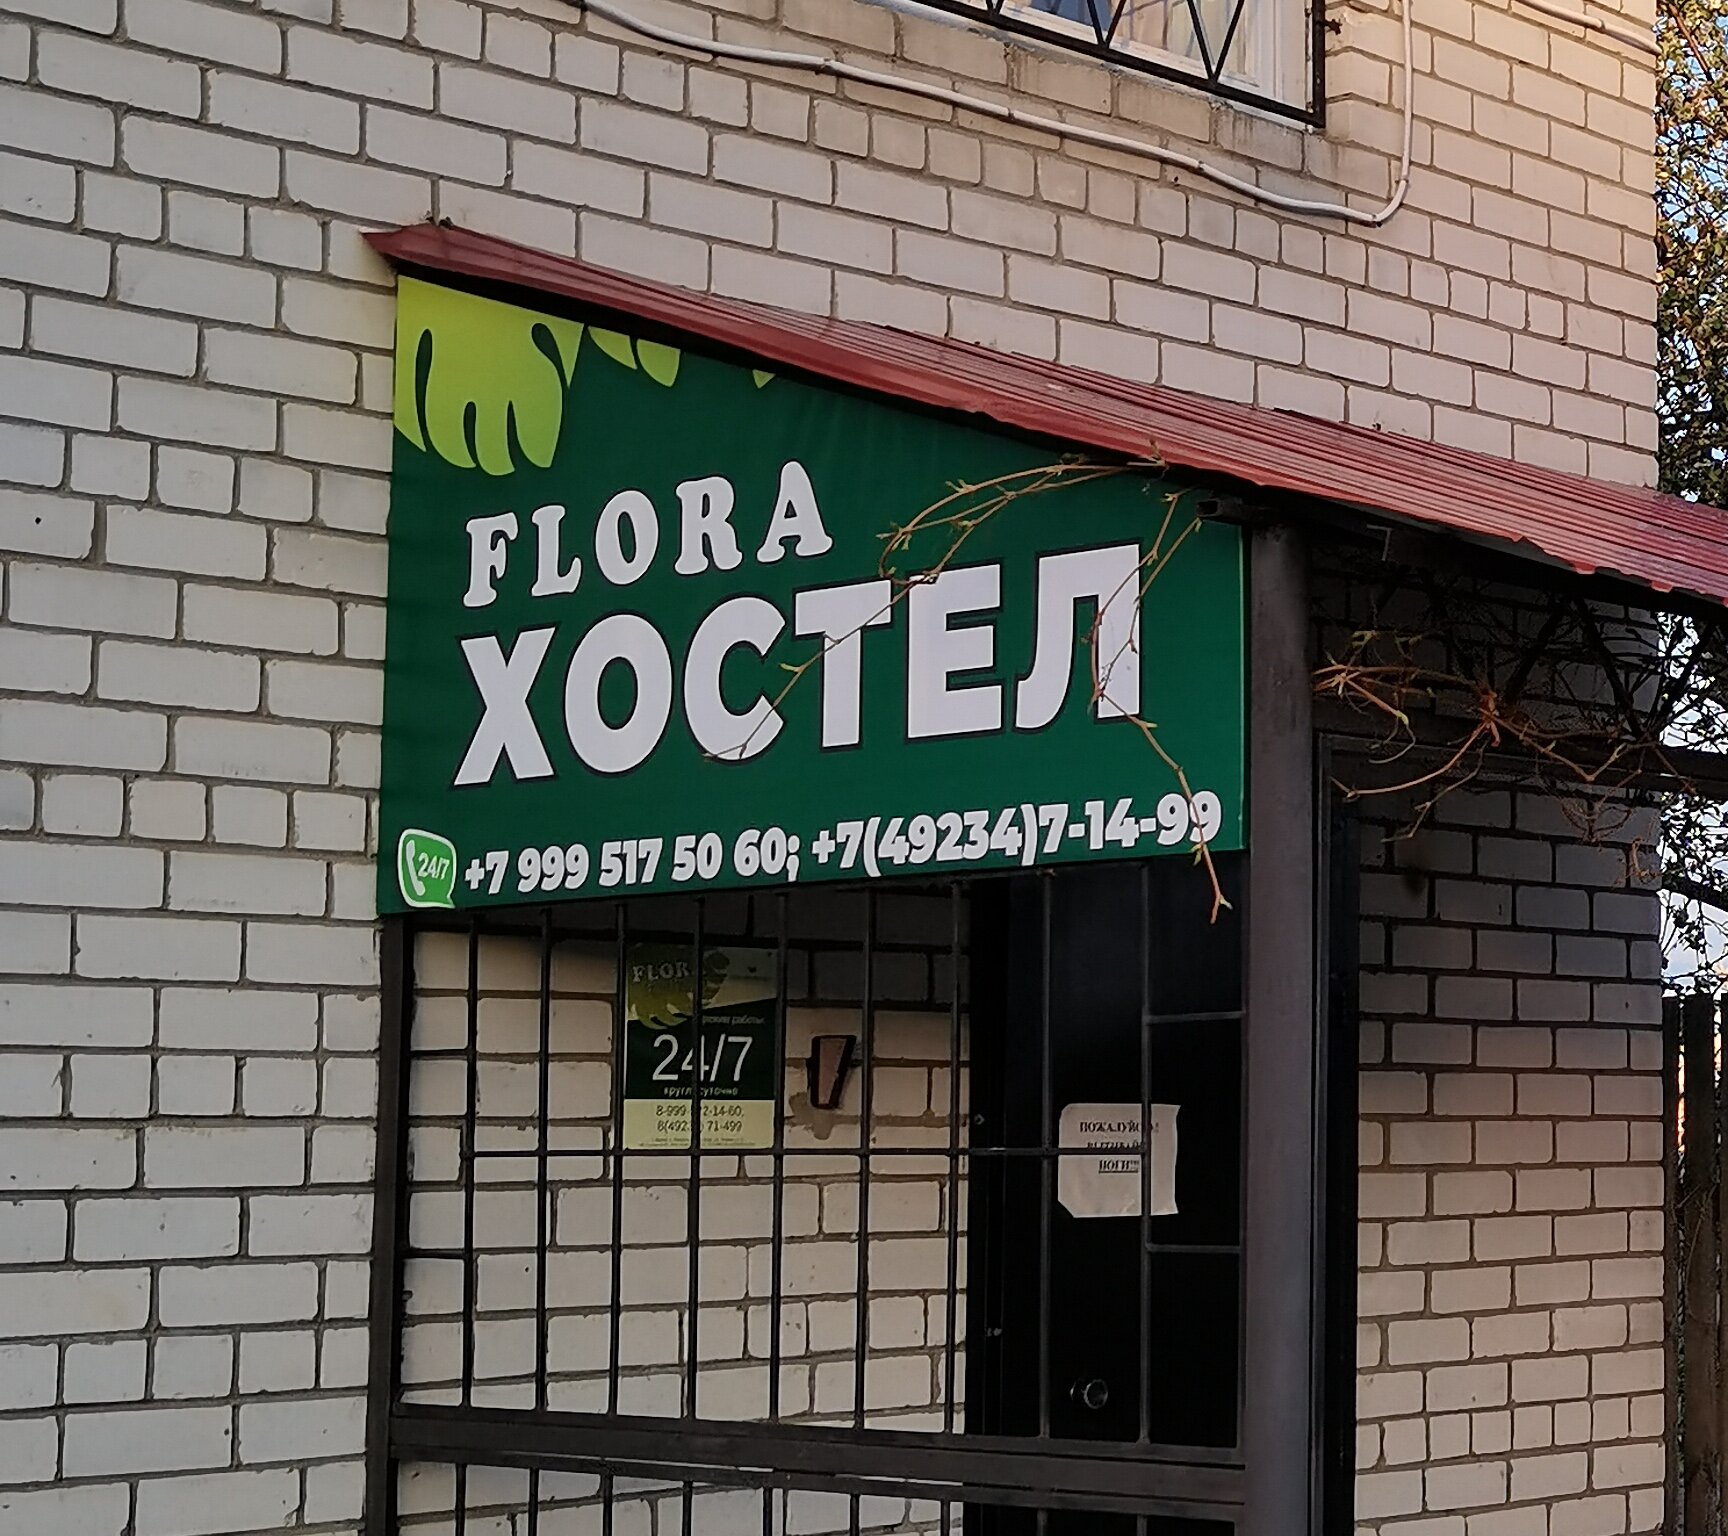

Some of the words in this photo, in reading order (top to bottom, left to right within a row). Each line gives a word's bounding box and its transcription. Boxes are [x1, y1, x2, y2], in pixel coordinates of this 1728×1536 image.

[462, 460, 834, 608] FLORA
[452, 543, 1143, 787] ХОСТЕЛ
[418, 852, 450, 881] 24/7
[464, 850, 509, 895] +7
[517, 844, 590, 894] 999
[599, 837, 663, 888] 517
[671, 832, 724, 882] 50
[733, 827, 801, 883] 60;
[812, 790, 1222, 878] +7(49234)7-14-99
[632, 961, 707, 982] FLOR
[652, 1033, 753, 1082] 24/7
